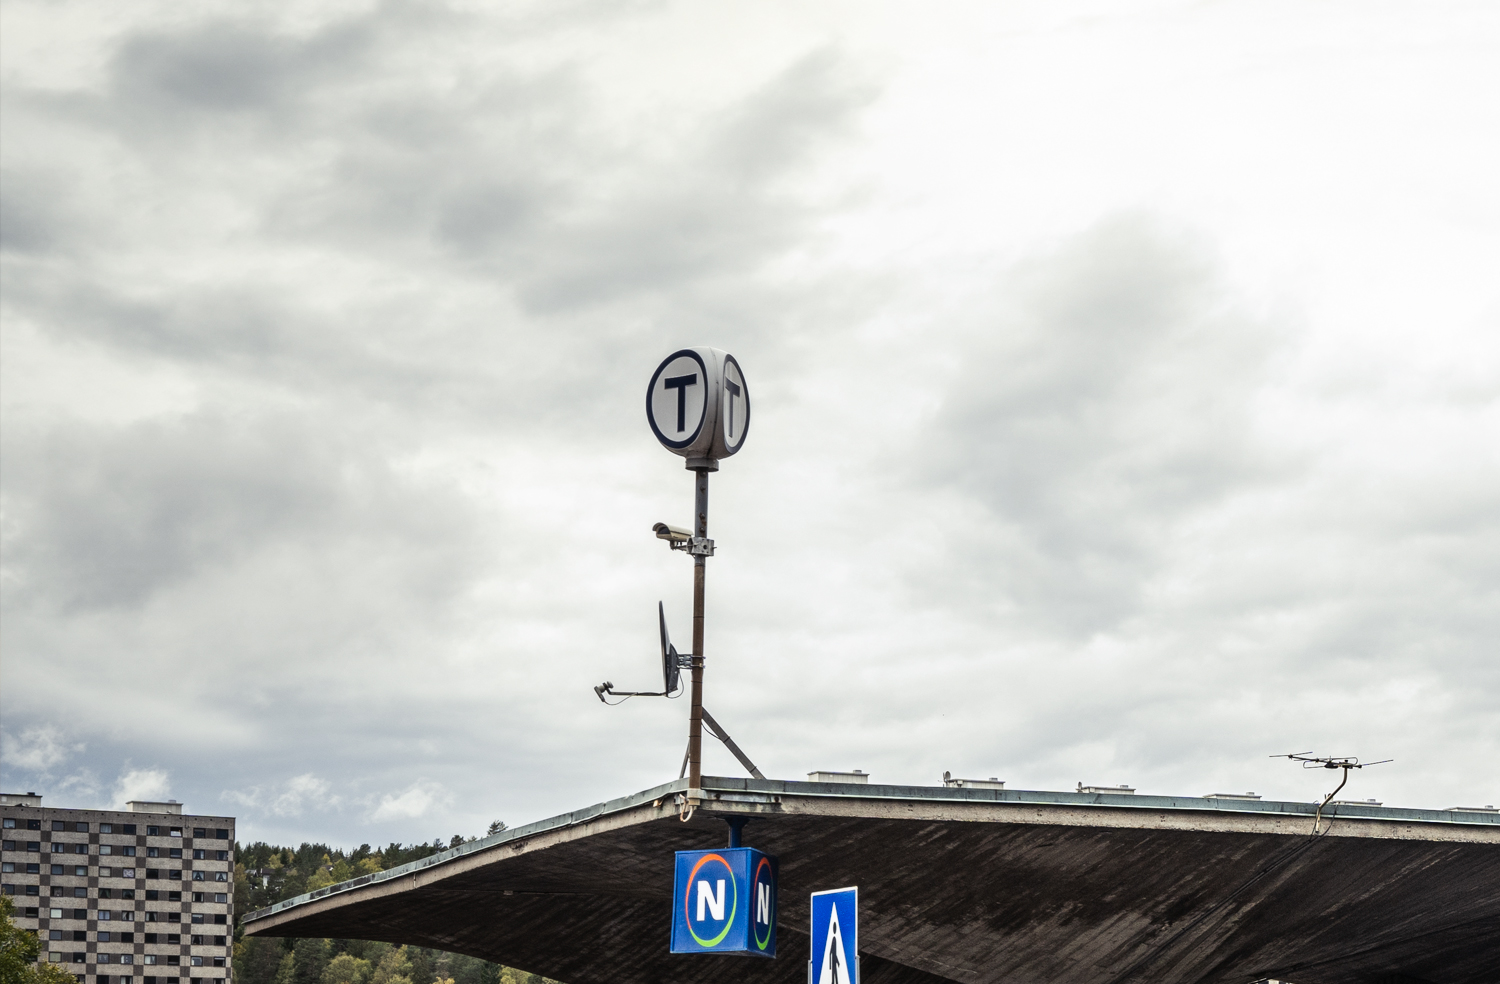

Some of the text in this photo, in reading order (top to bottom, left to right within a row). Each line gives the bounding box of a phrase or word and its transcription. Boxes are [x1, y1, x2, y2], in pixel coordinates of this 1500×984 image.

[664, 373, 697, 433] T
[725, 376, 741, 438] T
[696, 879, 726, 922] N
[757, 882, 770, 926] N
